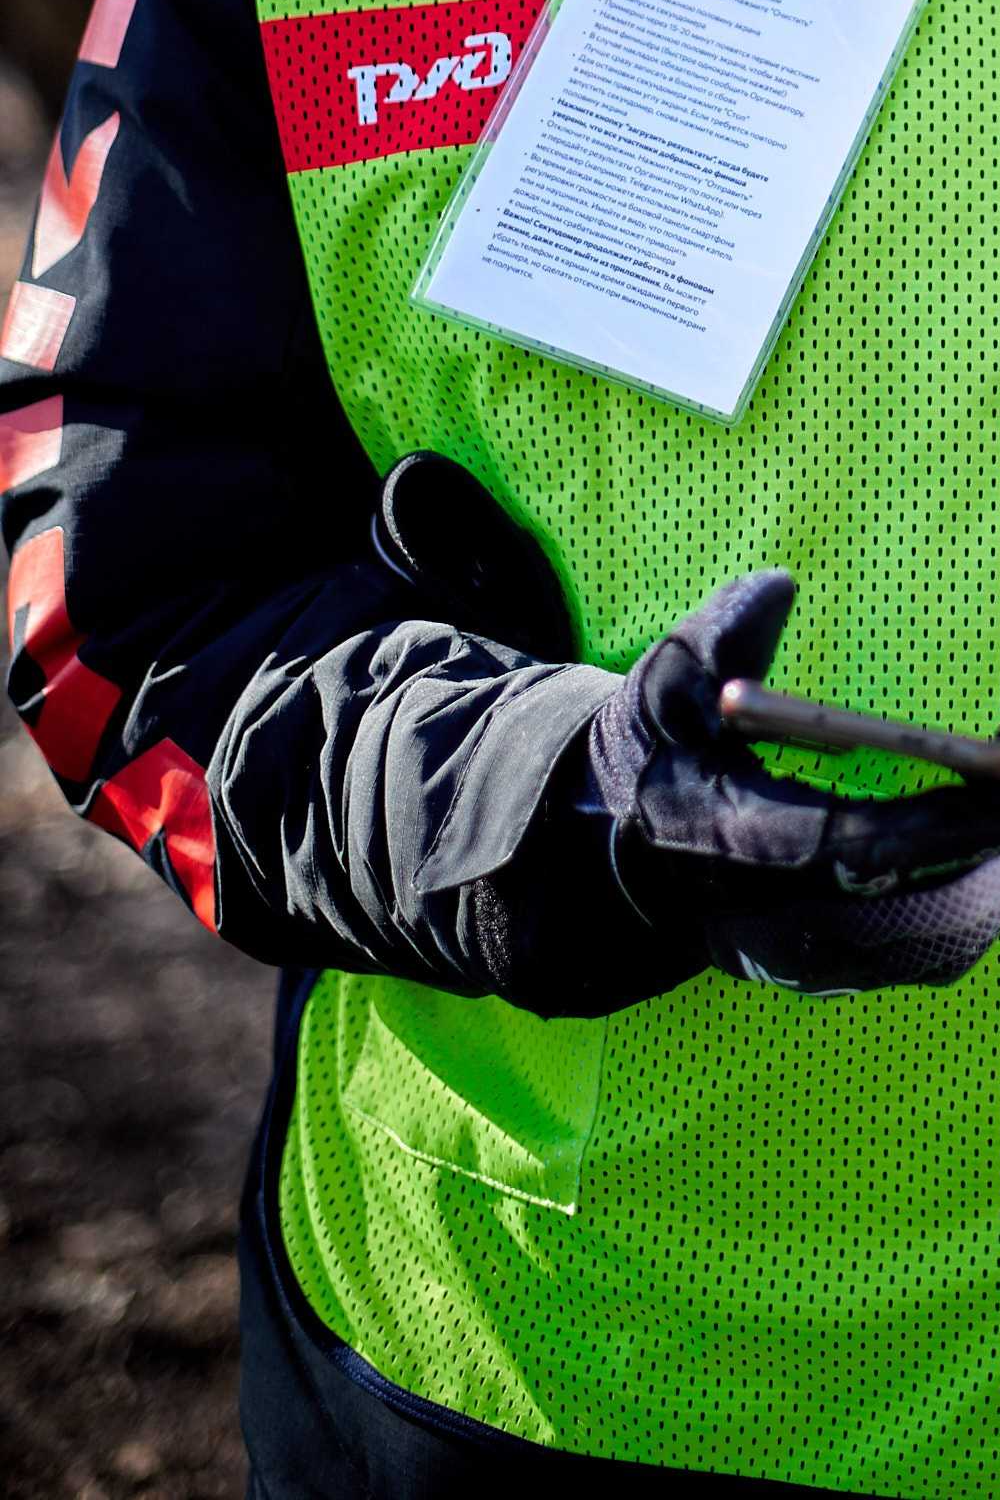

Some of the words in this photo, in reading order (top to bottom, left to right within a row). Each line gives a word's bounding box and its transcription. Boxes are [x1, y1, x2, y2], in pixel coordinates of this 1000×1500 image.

[556, 97, 595, 117] Нажмите
[593, 112, 624, 130] кнопку
[716, 158, 741, 173] когда
[740, 166, 769, 183] будете
[588, 123, 604, 134] что
[602, 128, 618, 139] все
[616, 134, 659, 155] участники
[657, 150, 702, 171] добрались
[700, 166, 714, 175] до
[712, 169, 747, 188] финиша
[501, 207, 534, 225] Важно!
[532, 219, 583, 245] Секундомер
[581, 239, 634, 263] продолжает
[631, 258, 670, 278] работать
[675, 274, 715, 295] фоновом
